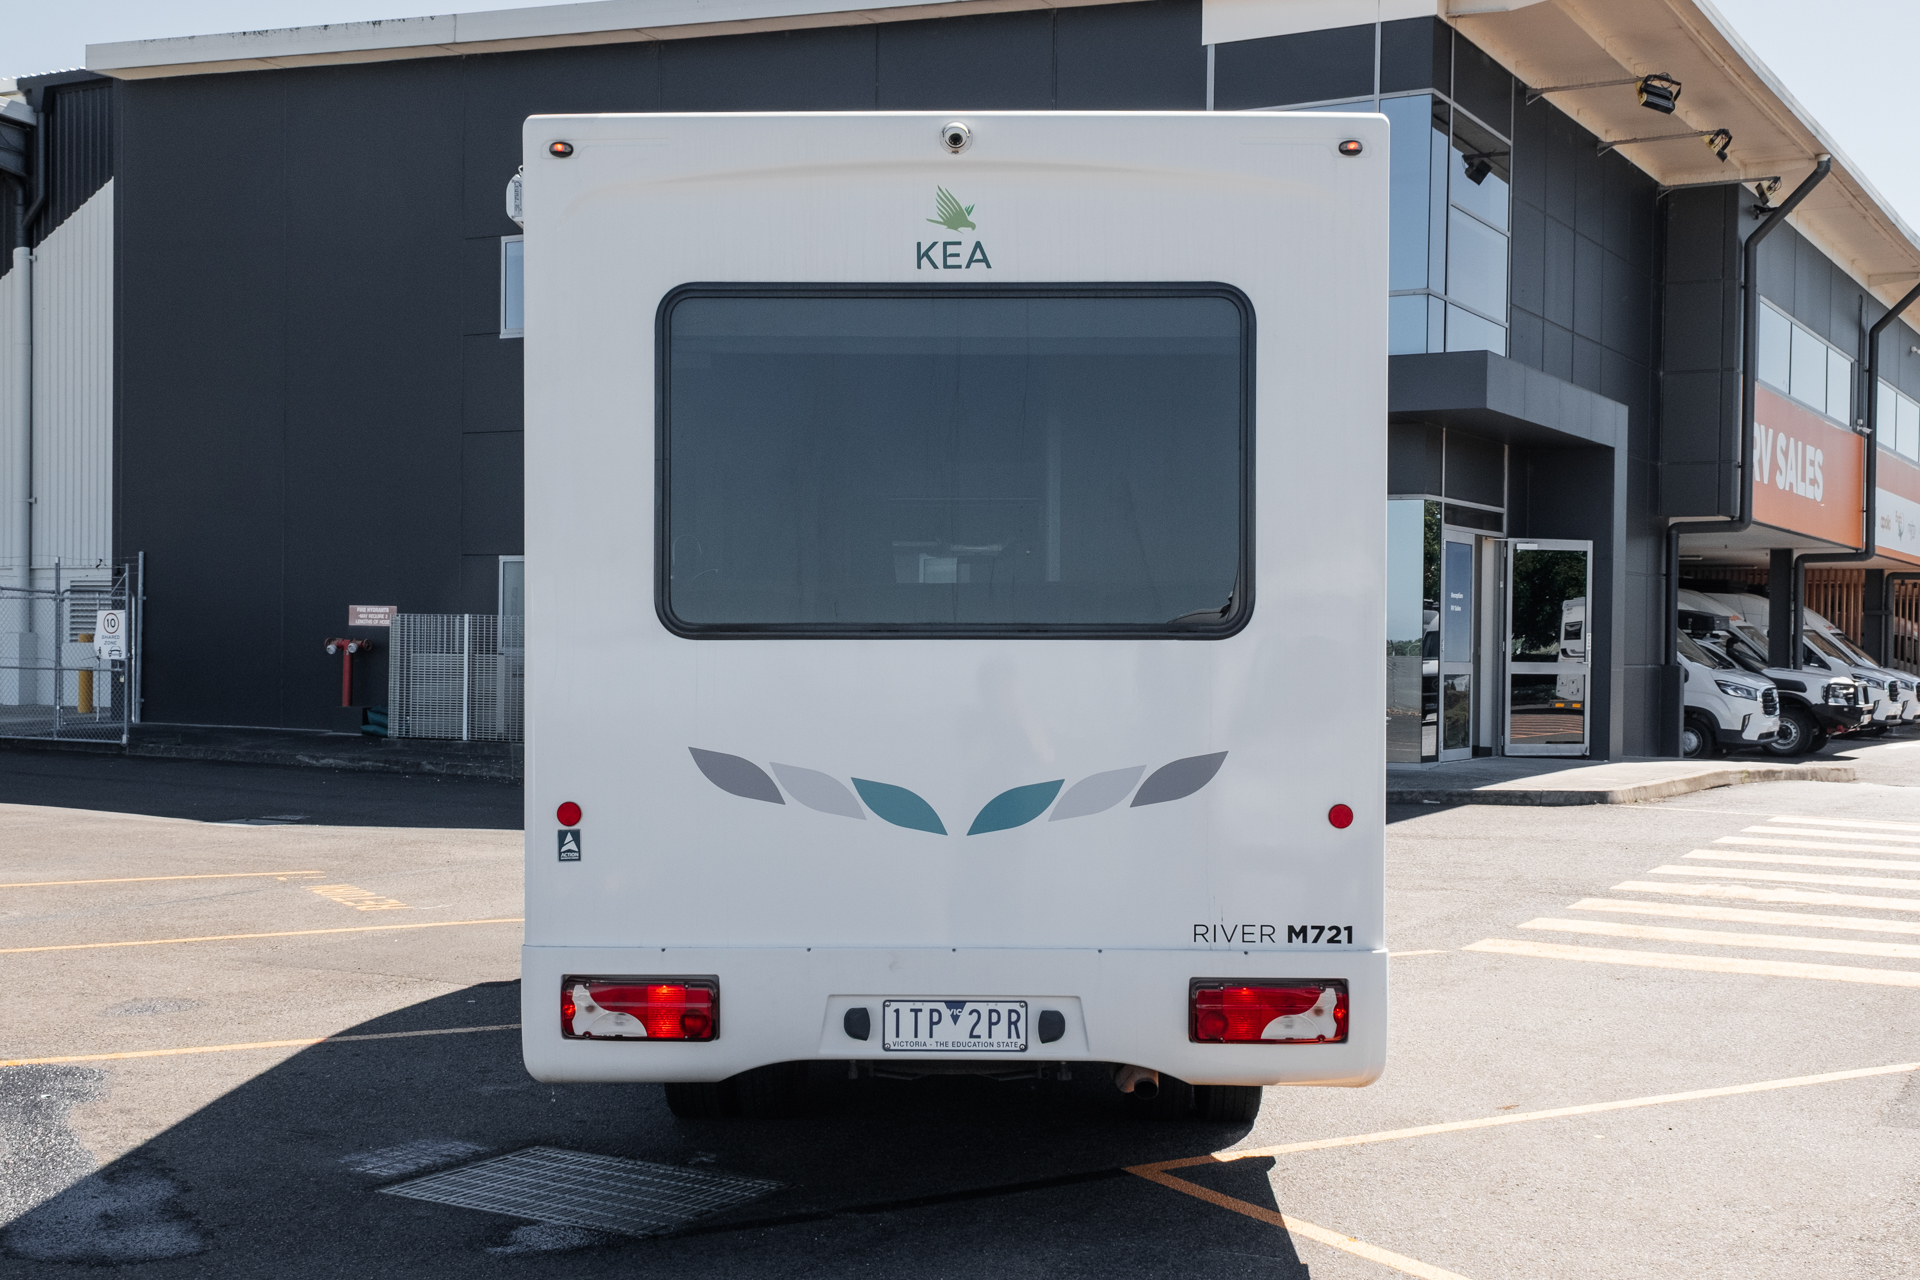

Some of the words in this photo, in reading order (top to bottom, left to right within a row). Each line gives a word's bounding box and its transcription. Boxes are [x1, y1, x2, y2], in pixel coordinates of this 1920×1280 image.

[916, 240, 992, 269] KEA
[1752, 421, 1774, 485] RV
[1776, 431, 1824, 502] SALES
[106, 618, 116, 628] 10
[1193, 924, 1276, 943] RIVER
[1287, 924, 1353, 944] M721
[893, 1007, 943, 1039] 1TP
[968, 1008, 1021, 1039] 2PR
[949, 1008, 963, 1016] VIC
